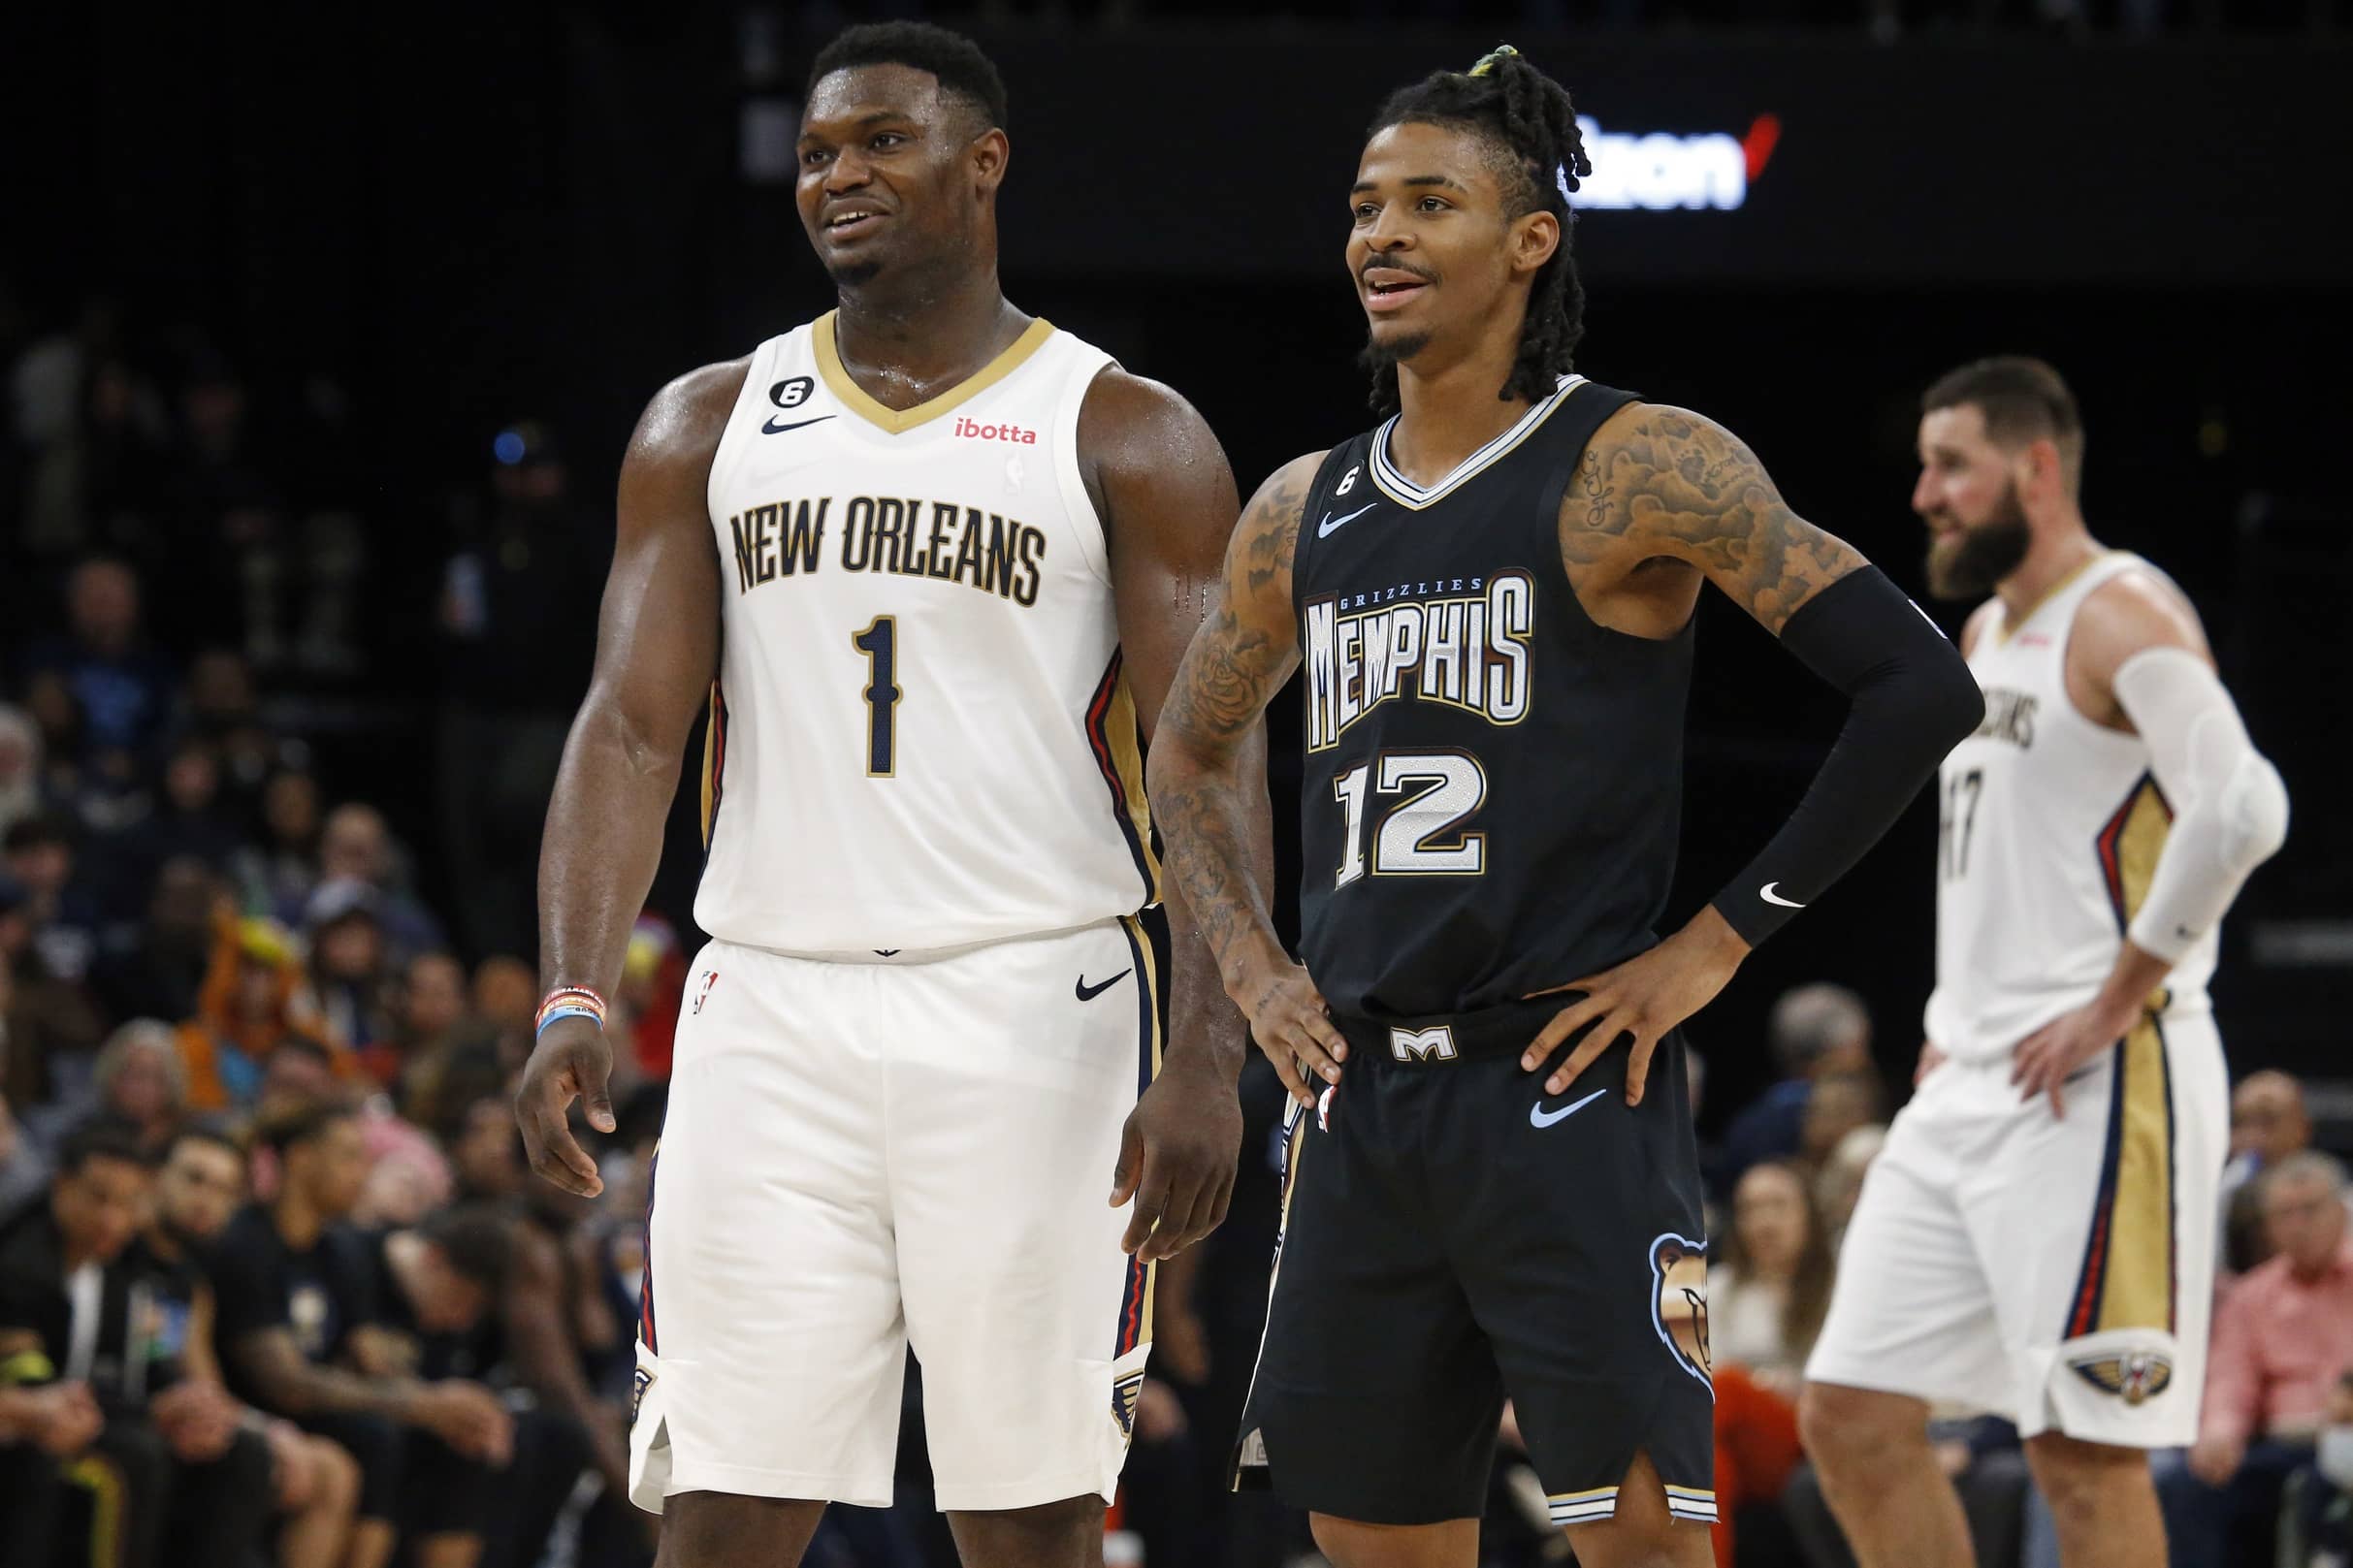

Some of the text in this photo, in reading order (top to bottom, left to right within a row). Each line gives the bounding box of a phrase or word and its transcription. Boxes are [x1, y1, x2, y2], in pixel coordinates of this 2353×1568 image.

[778, 381, 807, 405] 6
[955, 418, 1037, 444] ibotta
[1335, 464, 1360, 497] 6
[729, 496, 1047, 607] NEW ORLEANS
[1340, 577, 1483, 611] GRIZZLIES
[851, 613, 904, 779] 1
[1333, 746, 1489, 890] 12
